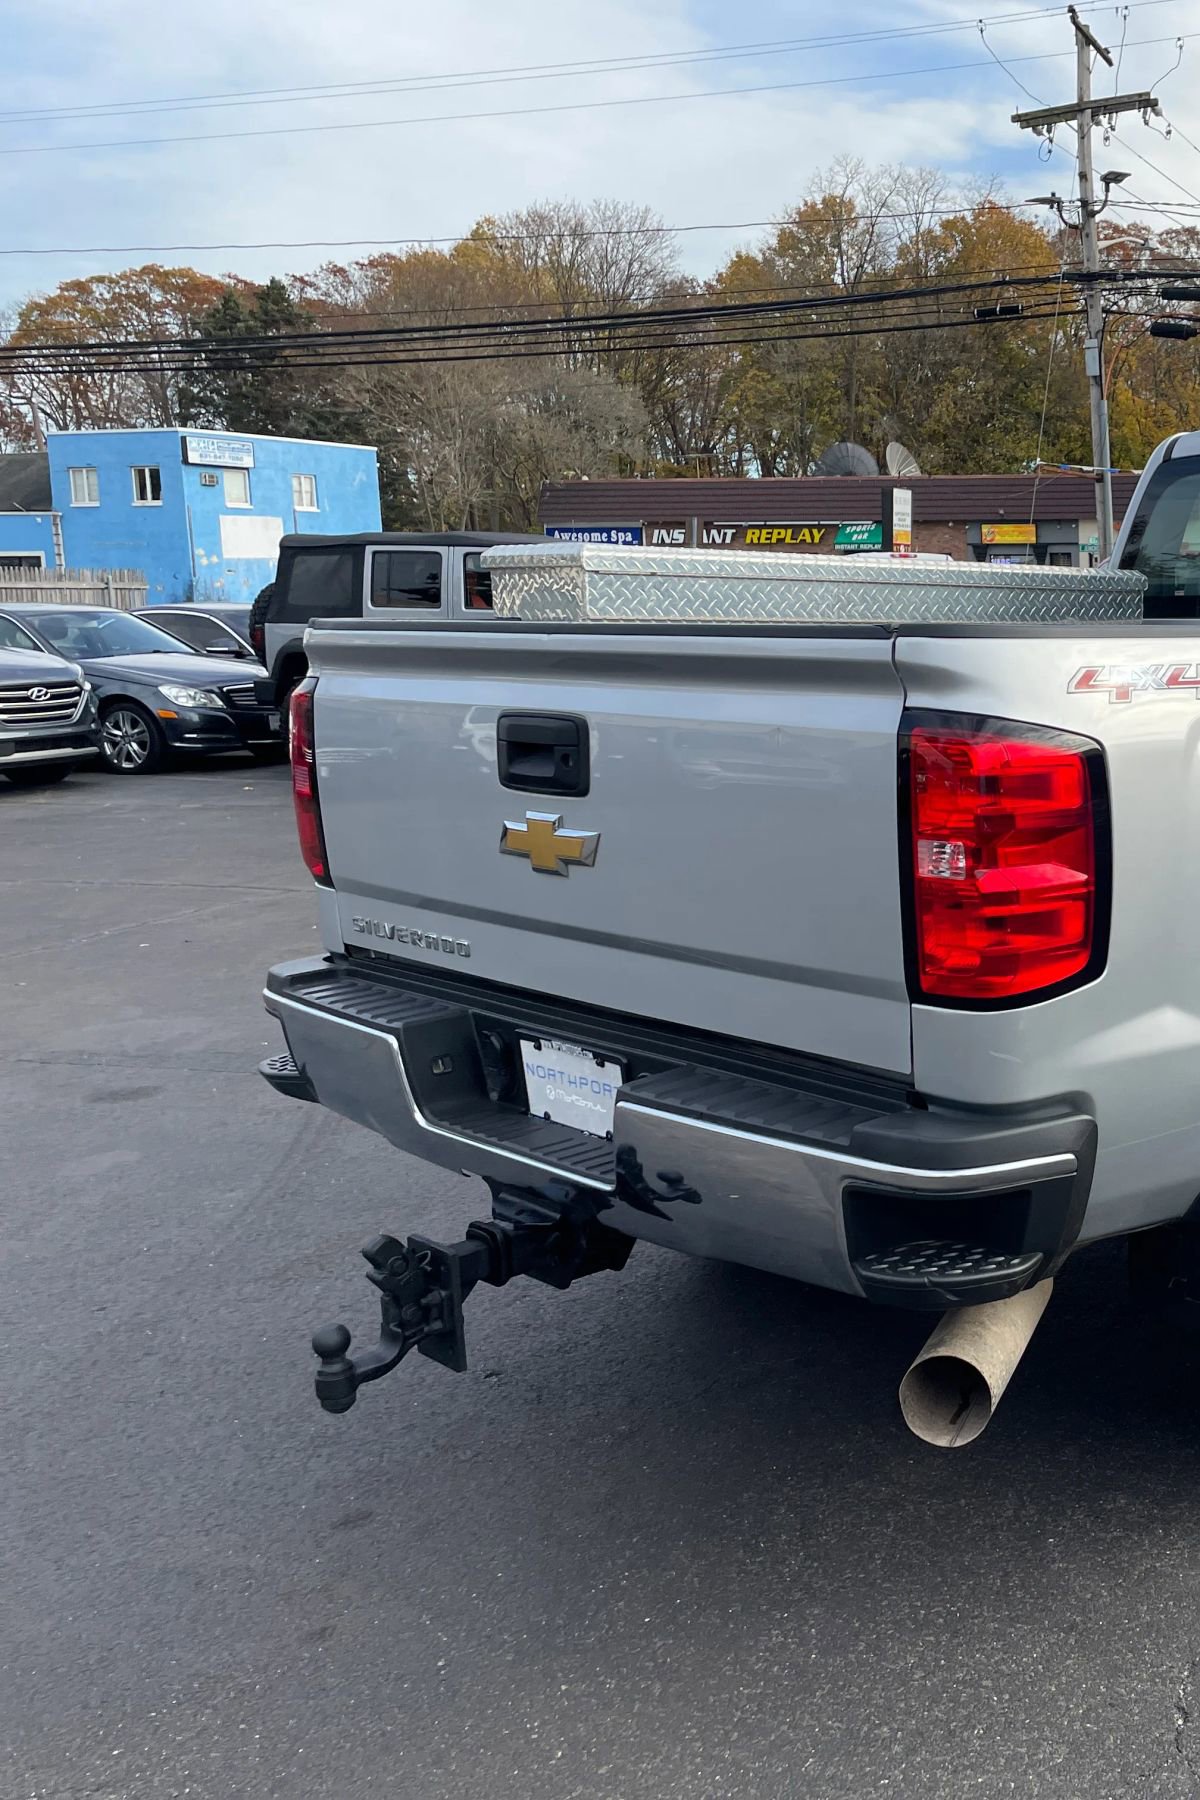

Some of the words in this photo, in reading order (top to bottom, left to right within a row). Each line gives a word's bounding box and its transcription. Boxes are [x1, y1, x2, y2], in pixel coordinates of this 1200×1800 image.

[745, 528, 826, 544] REPLAY
[845, 523, 877, 534] SPORTS
[851, 532, 869, 541] BAR
[553, 529, 608, 542] Awesome
[611, 529, 633, 545] Spa
[352, 915, 471, 957] SILVERADO
